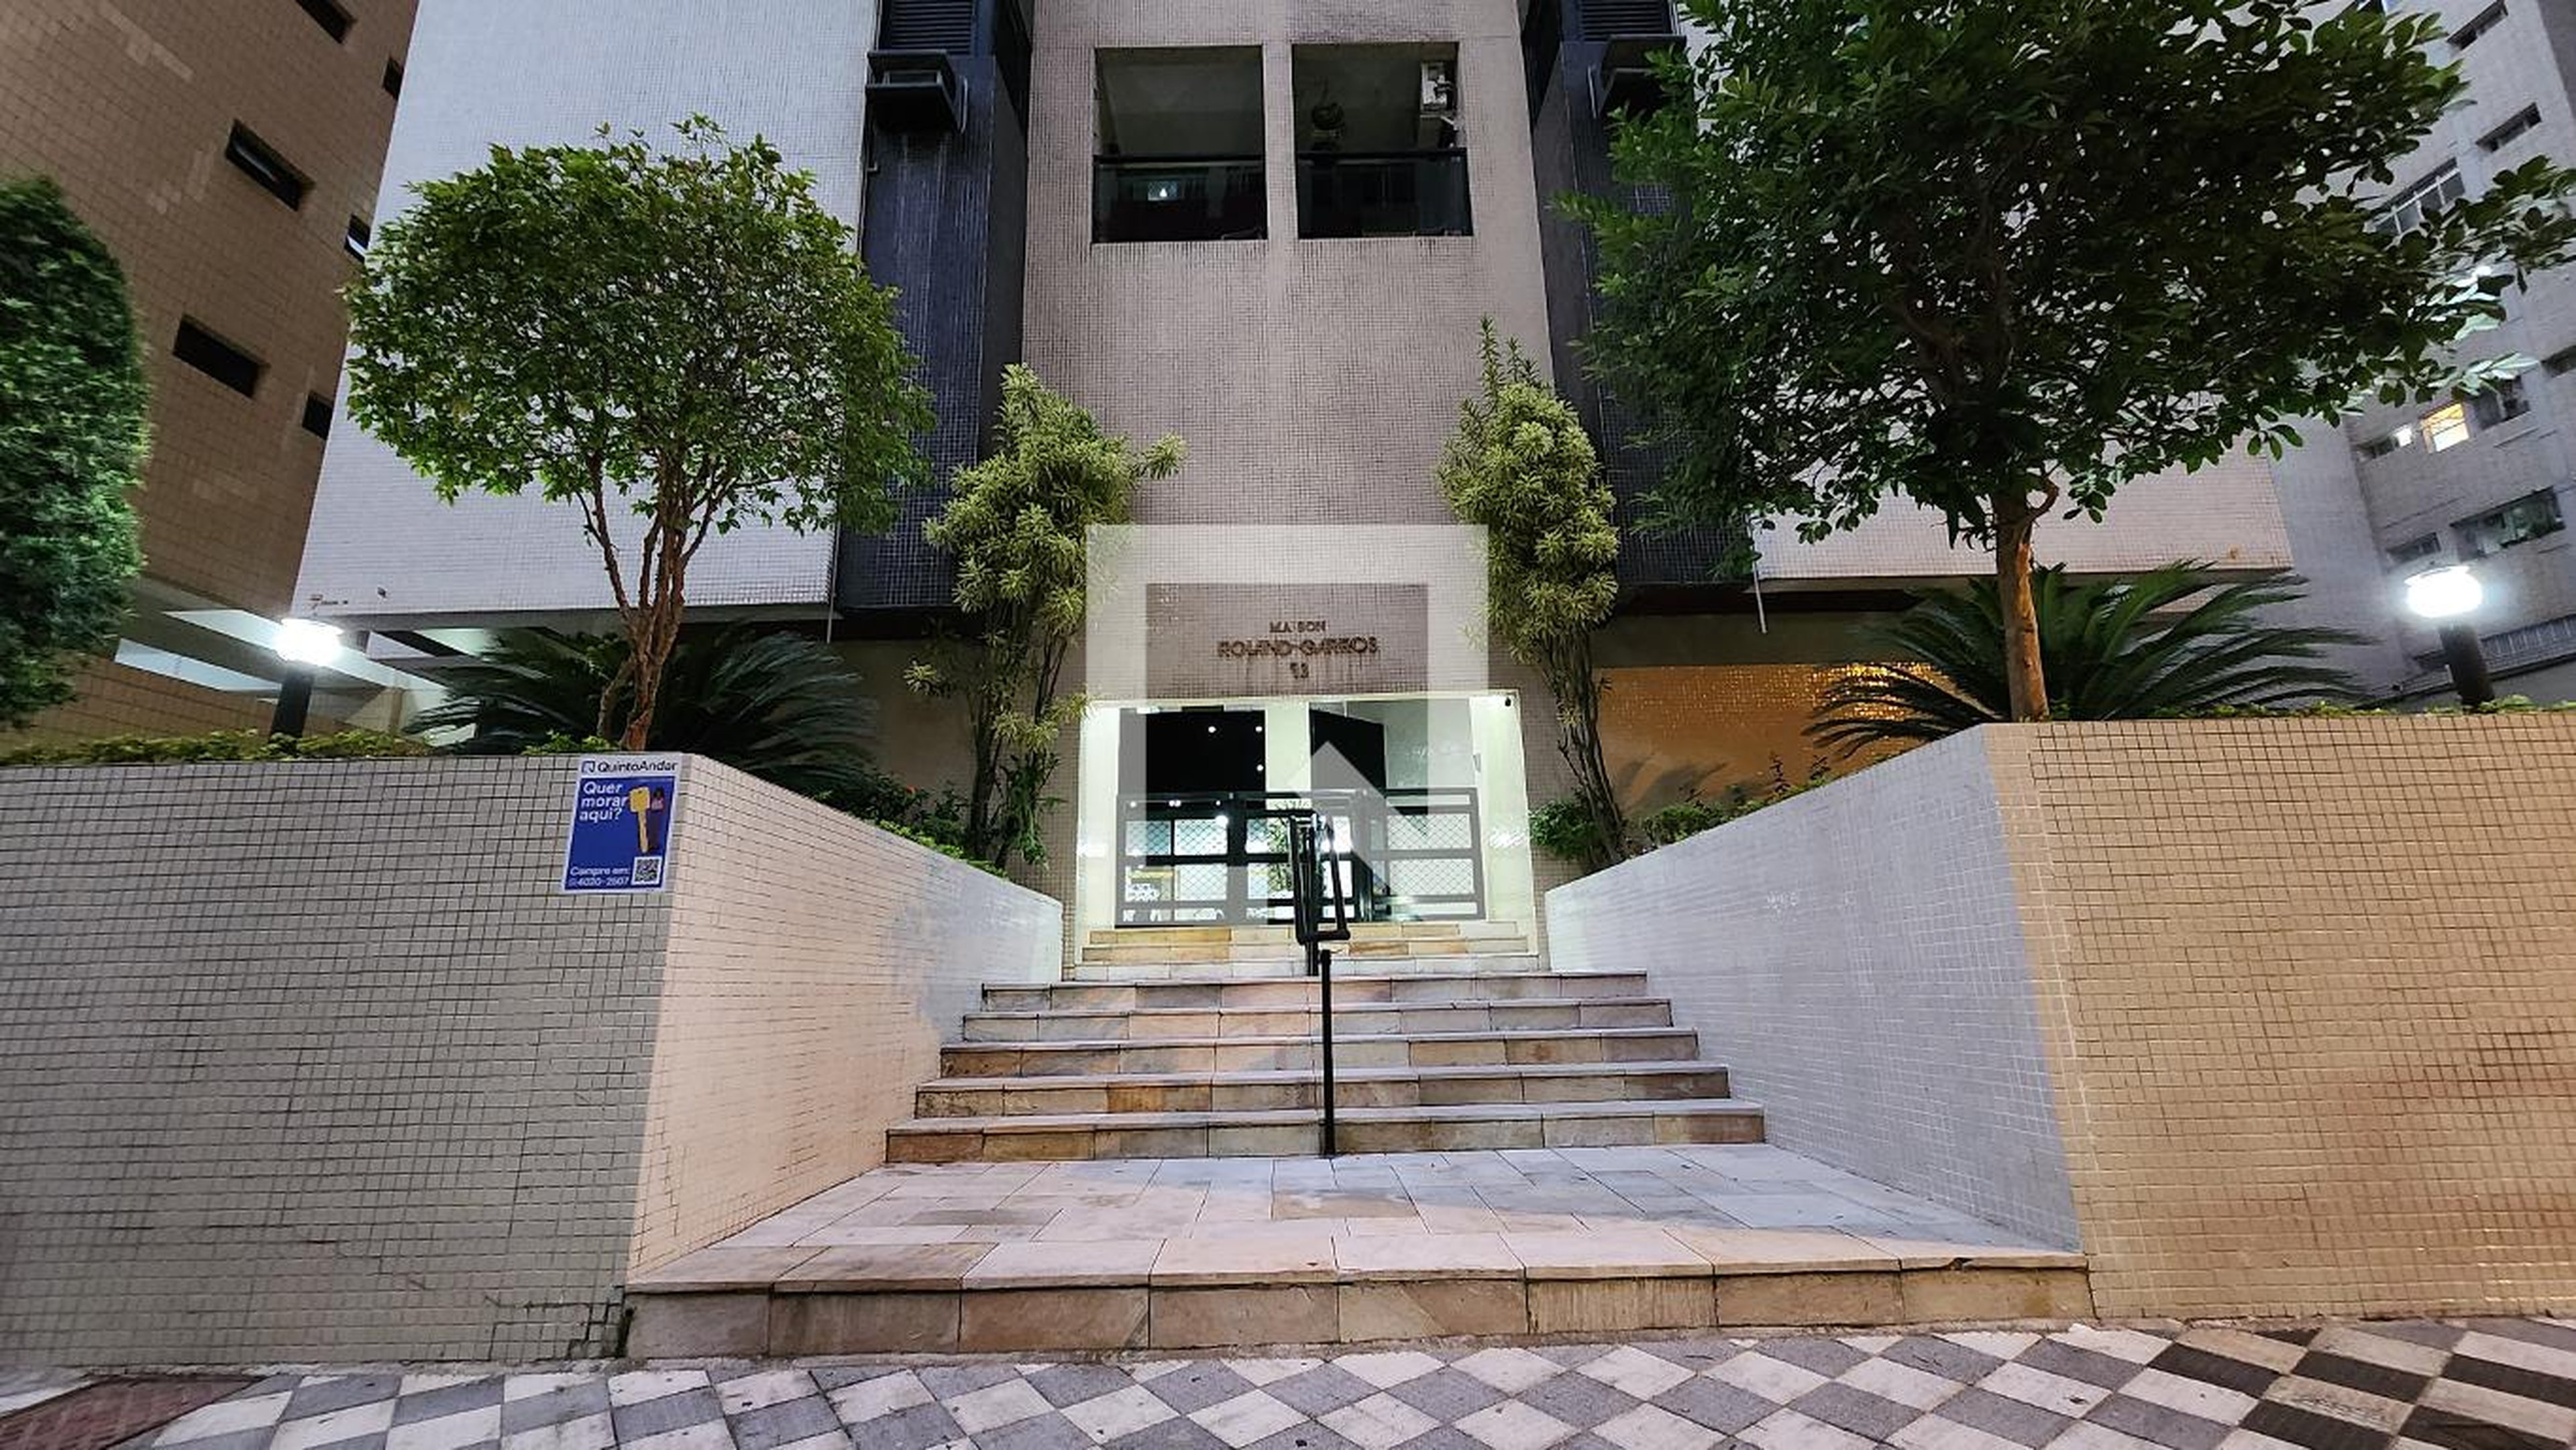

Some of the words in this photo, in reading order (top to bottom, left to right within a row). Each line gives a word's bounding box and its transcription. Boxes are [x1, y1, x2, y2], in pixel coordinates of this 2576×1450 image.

[1269, 621, 1326, 633] MAISON
[598, 761, 678, 773] QuintoAndar
[582, 781, 623, 794] Quer
[580, 795, 629, 808] morar
[579, 807, 623, 823] aqui?
[570, 867, 611, 877] Compre
